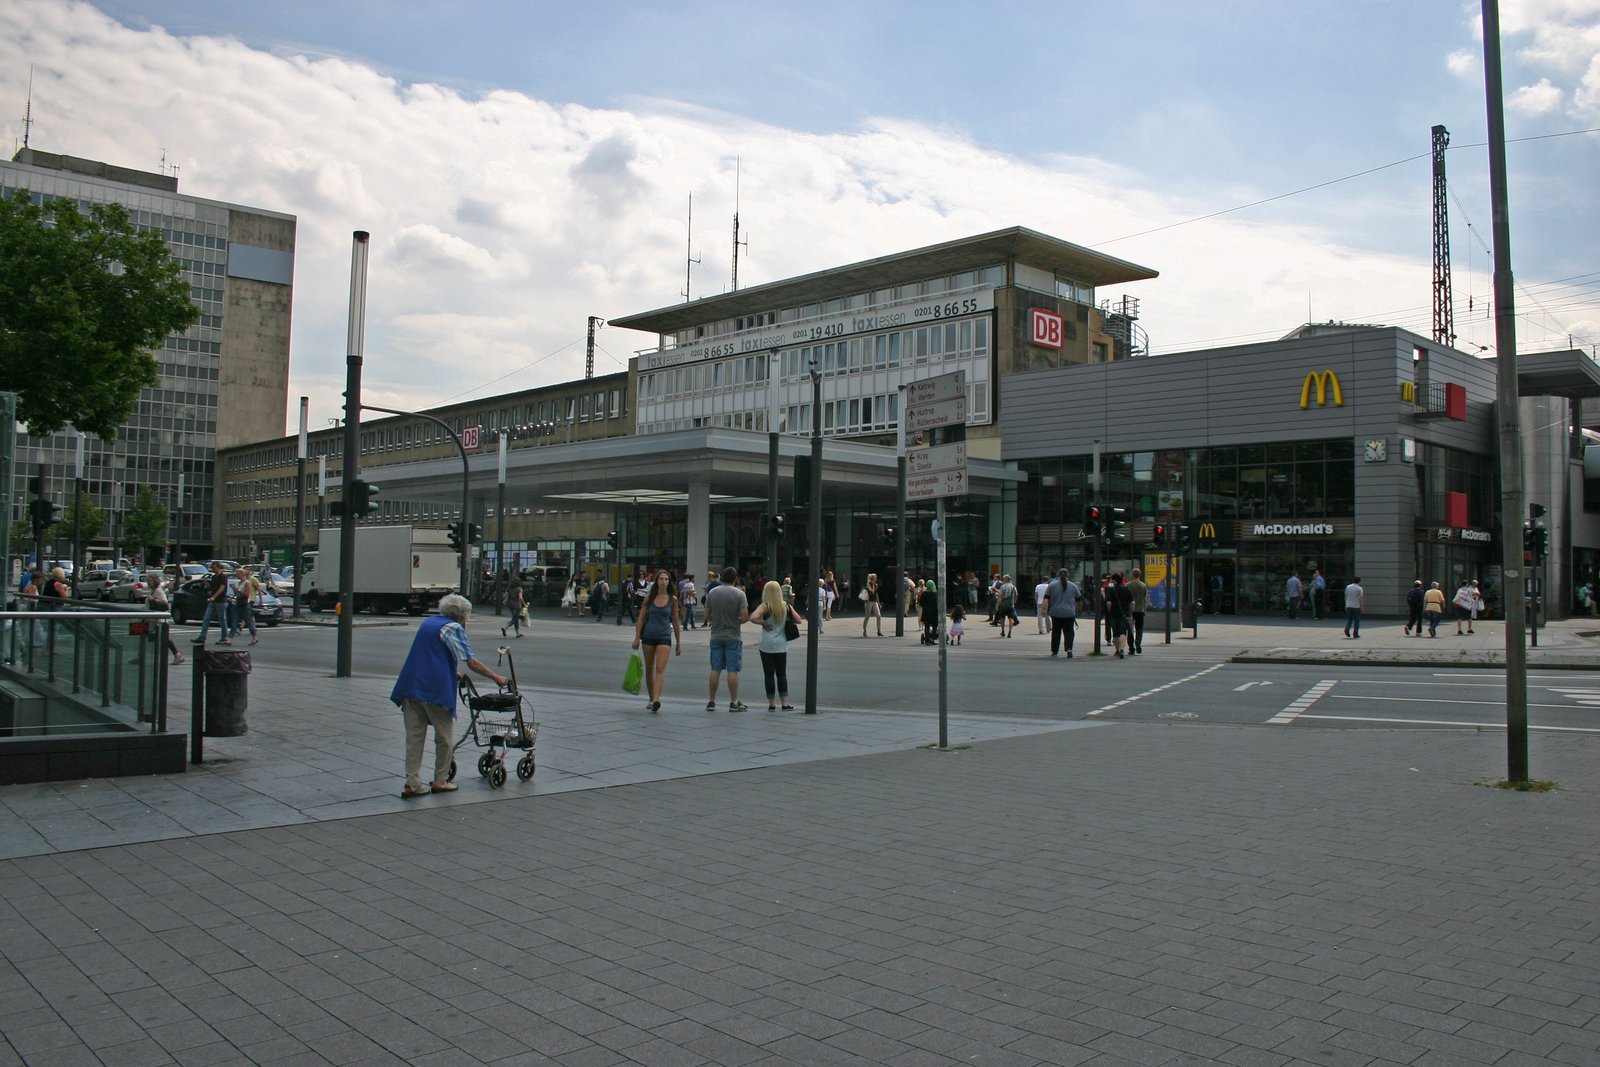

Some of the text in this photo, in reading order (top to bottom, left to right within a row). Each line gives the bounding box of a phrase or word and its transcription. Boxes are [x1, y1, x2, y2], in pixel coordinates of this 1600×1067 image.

[914, 306, 932, 317] 0201
[933, 305, 941, 318] 8
[944, 301, 959, 316] 66
[962, 298, 977, 313] 55
[793, 329, 808, 339] 0201
[810, 326, 822, 339] 19
[825, 322, 844, 337] 410
[1035, 314, 1060, 343] DB
[690, 348, 703, 358] 0201
[703, 347, 709, 359] 8
[711, 345, 722, 357] 66
[724, 343, 735, 355] 55
[464, 430, 477, 447] DB
[1253, 523, 1334, 535] McDonald's
